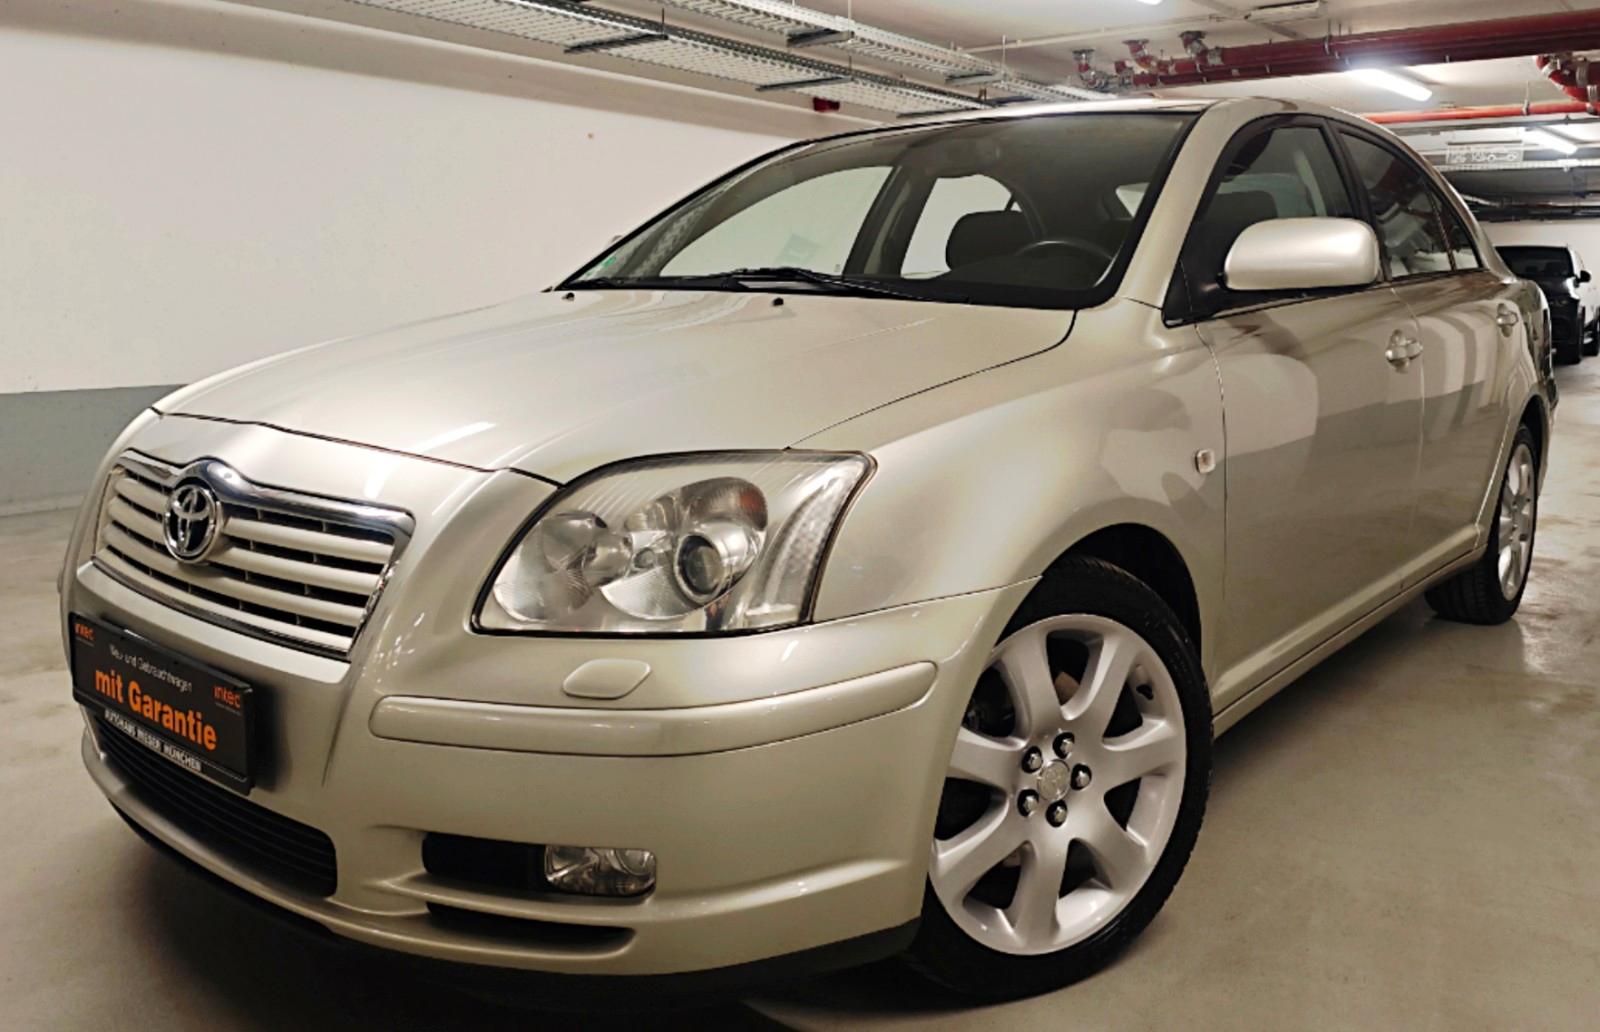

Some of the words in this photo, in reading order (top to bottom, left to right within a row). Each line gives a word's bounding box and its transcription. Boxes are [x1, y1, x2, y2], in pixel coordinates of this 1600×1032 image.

[138, 656, 193, 694] Gebrauchtwagen
[95, 669, 123, 705] mit
[128, 680, 217, 752] Garantie
[163, 742, 202, 773] MÜNCHEN
